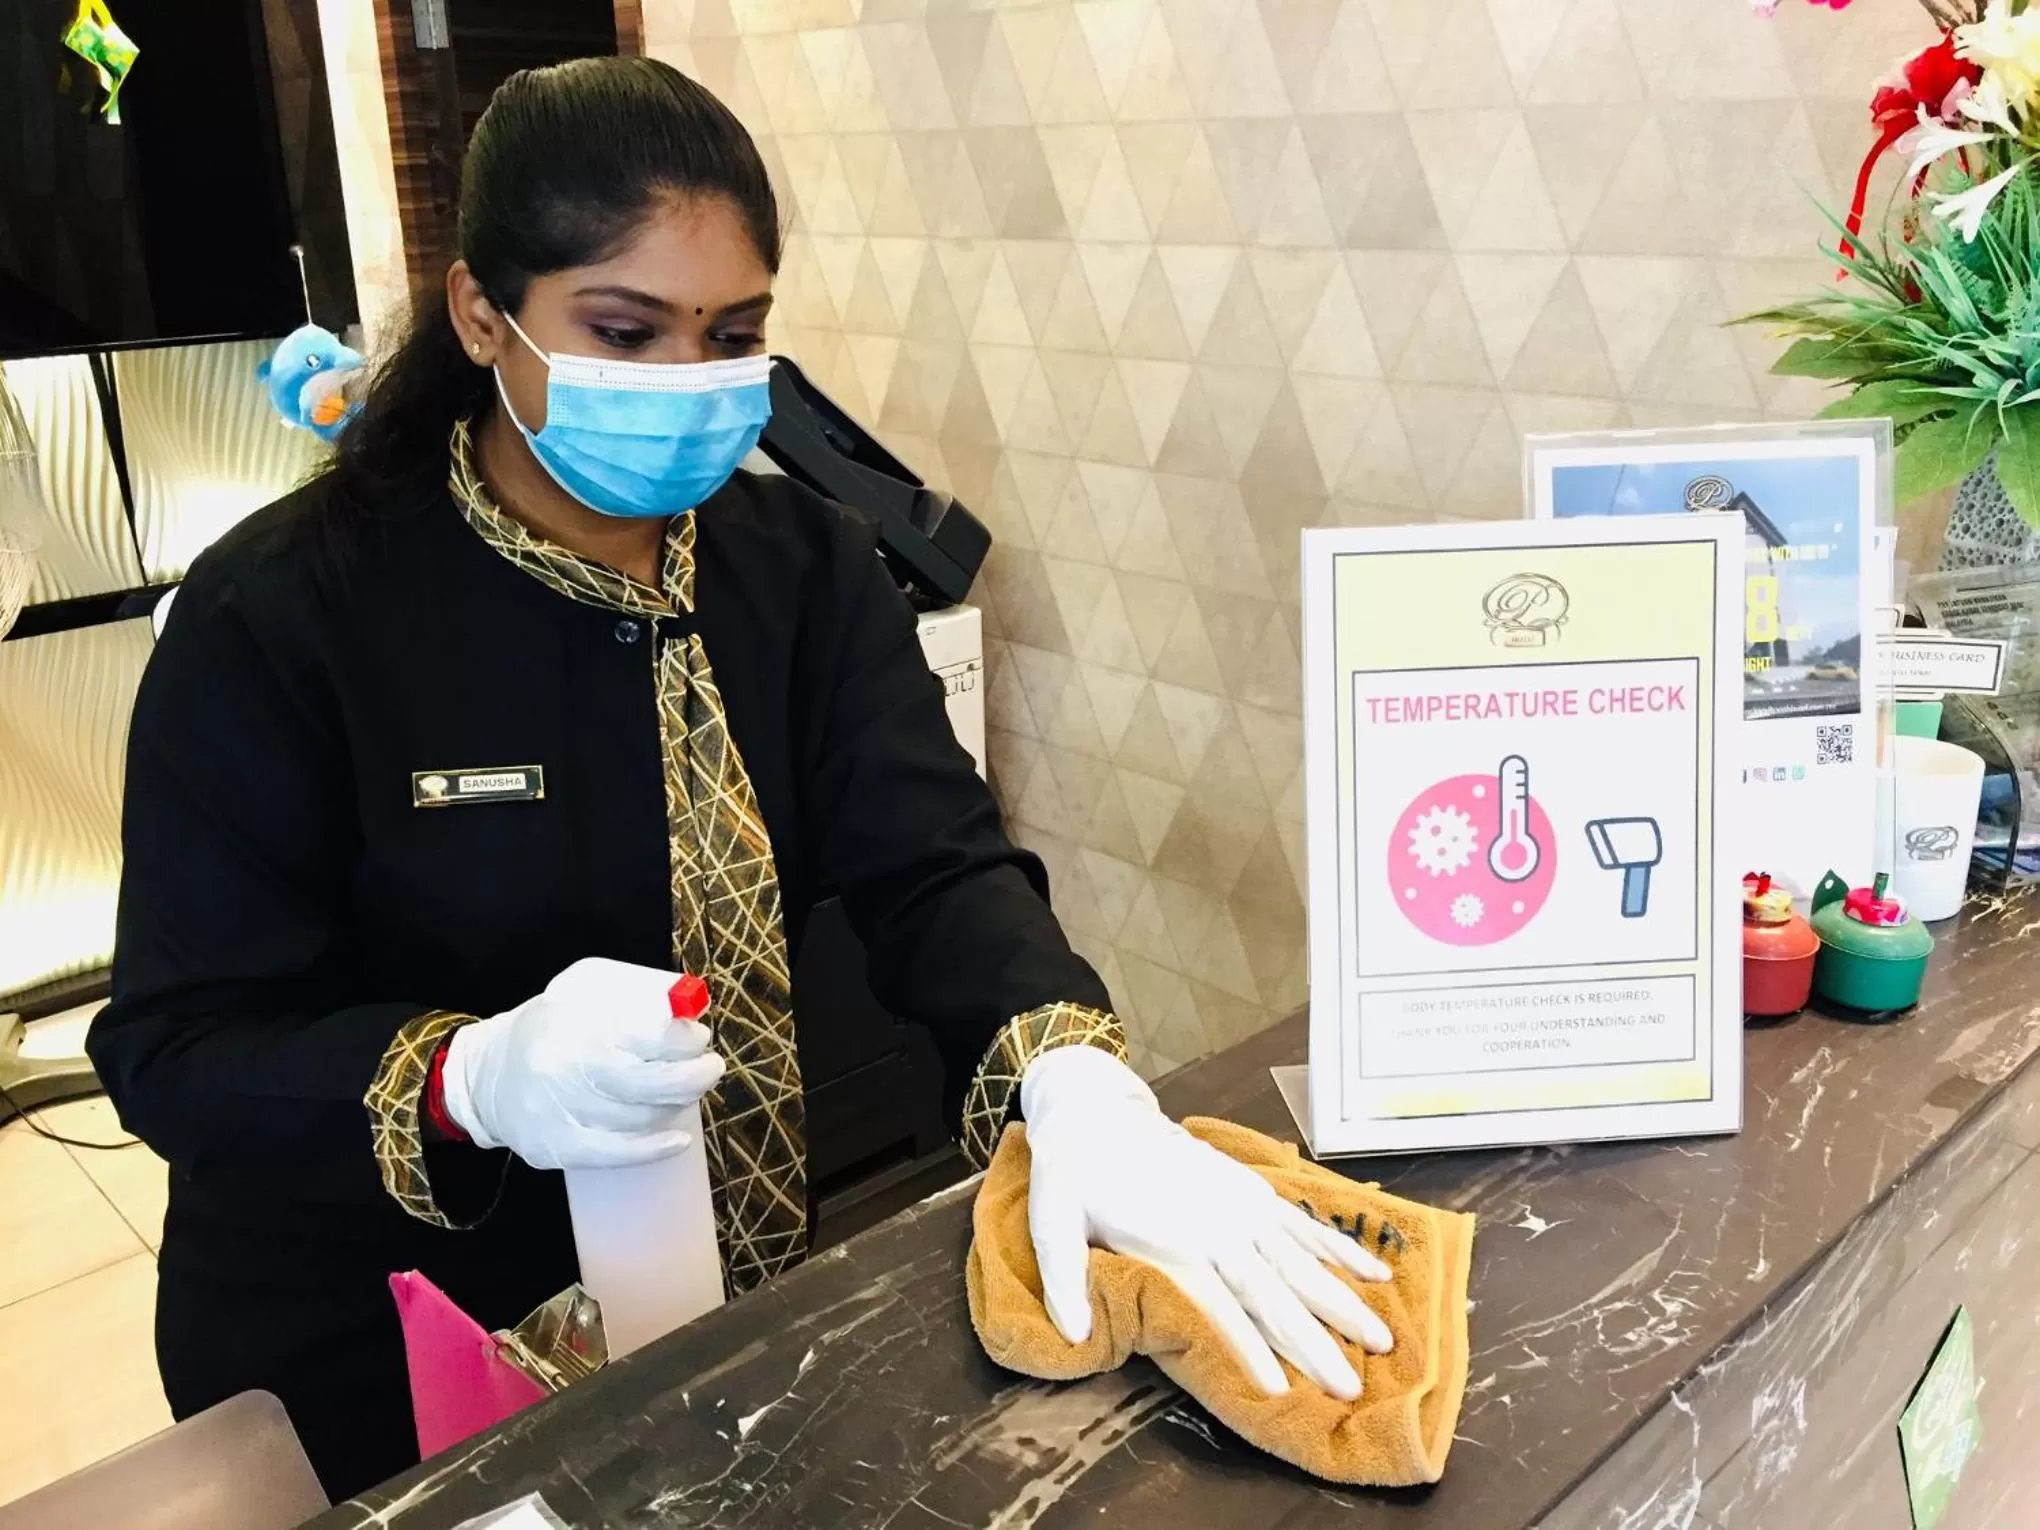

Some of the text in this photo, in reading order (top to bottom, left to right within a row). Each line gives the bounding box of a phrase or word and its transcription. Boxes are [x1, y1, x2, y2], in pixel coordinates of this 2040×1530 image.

[1746, 575, 1778, 643] 8
[1949, 652, 1986, 663] CARD
[1367, 685, 1686, 724] TEMPERATURE CHECK
[463, 777, 522, 789] SANUSHA
[1440, 996, 1529, 1011] TEMPERATURE
[1532, 993, 1570, 1008] CHECK
[1574, 991, 1586, 1005] IS
[1530, 1015, 1636, 1031] UNDERSTANDING
[1639, 1013, 1666, 1025] AND
